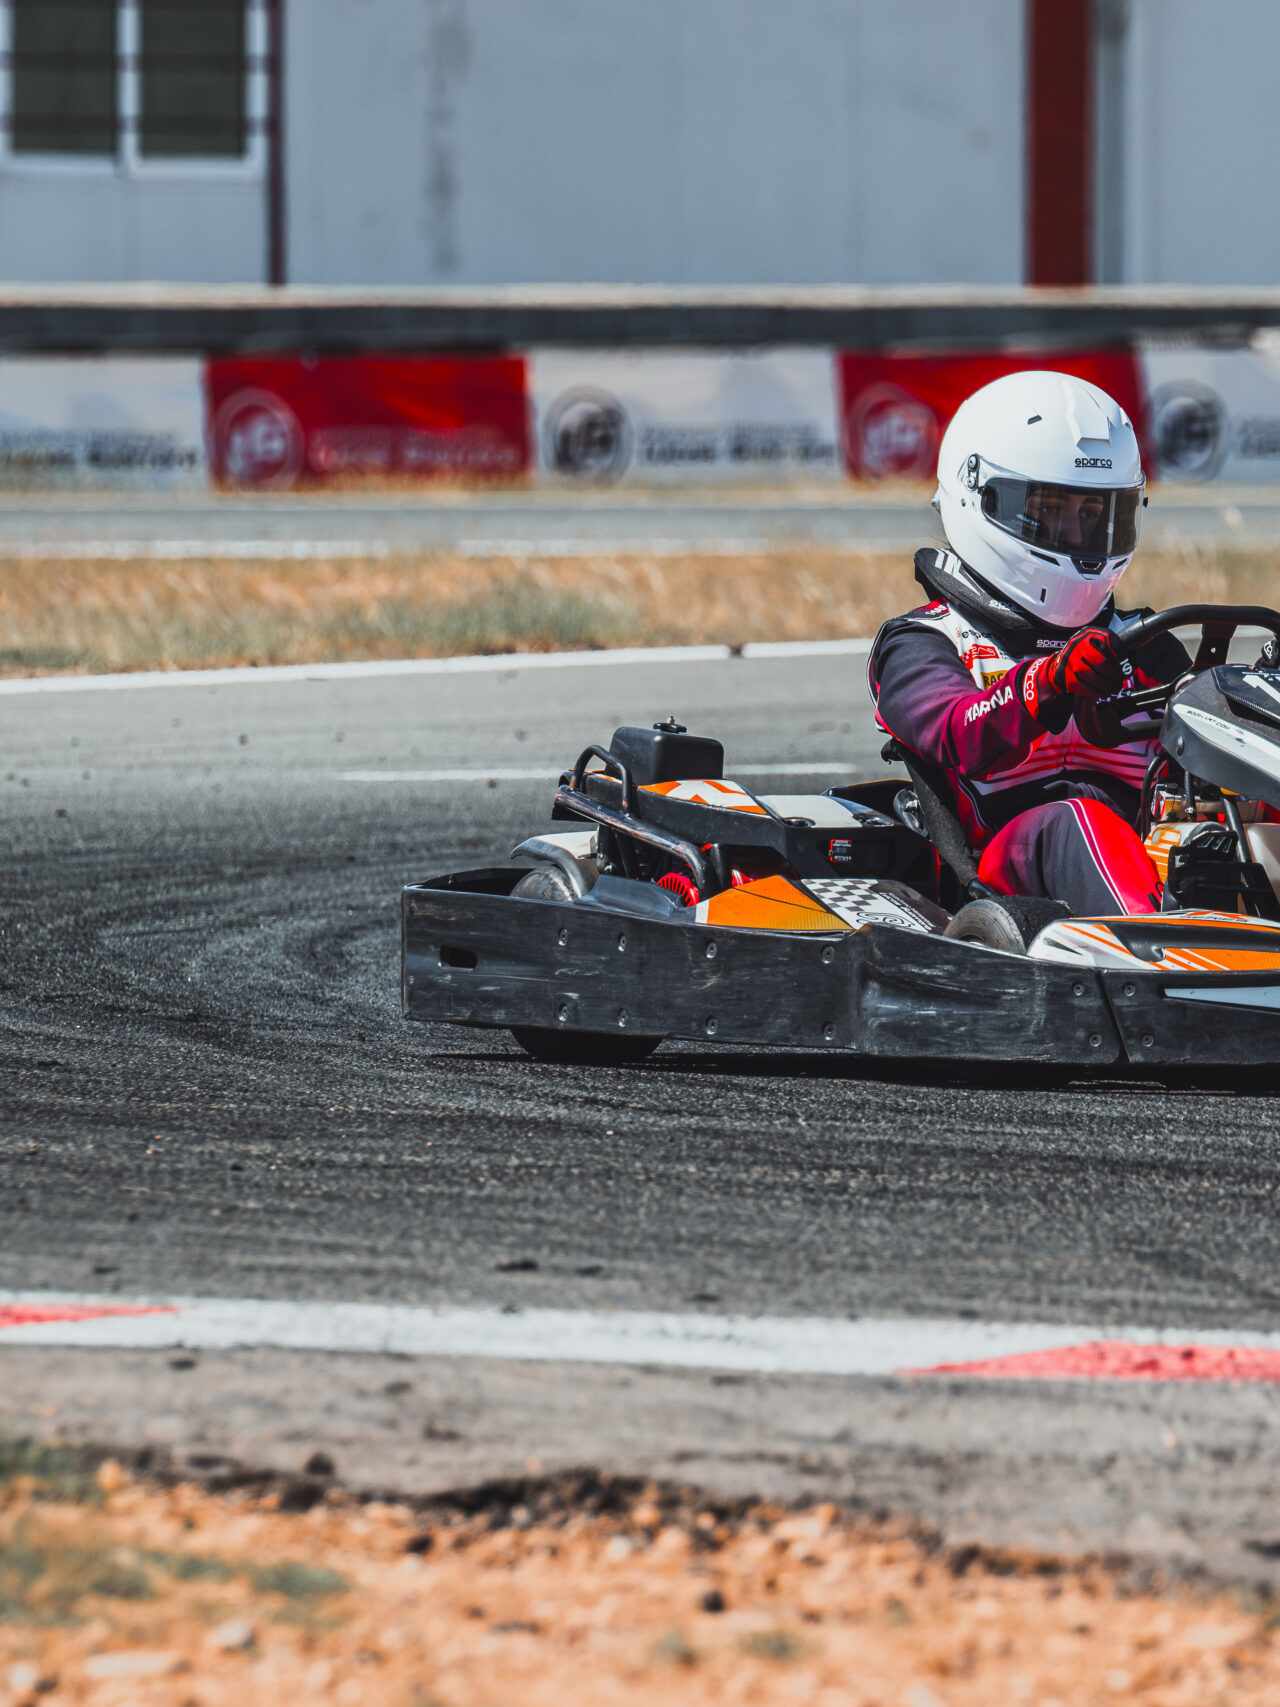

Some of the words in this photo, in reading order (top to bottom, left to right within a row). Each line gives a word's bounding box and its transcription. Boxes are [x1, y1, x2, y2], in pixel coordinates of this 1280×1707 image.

[1074, 457, 1113, 470] sparco
[1036, 639, 1068, 649] sparc
[1023, 656, 1049, 702] parco
